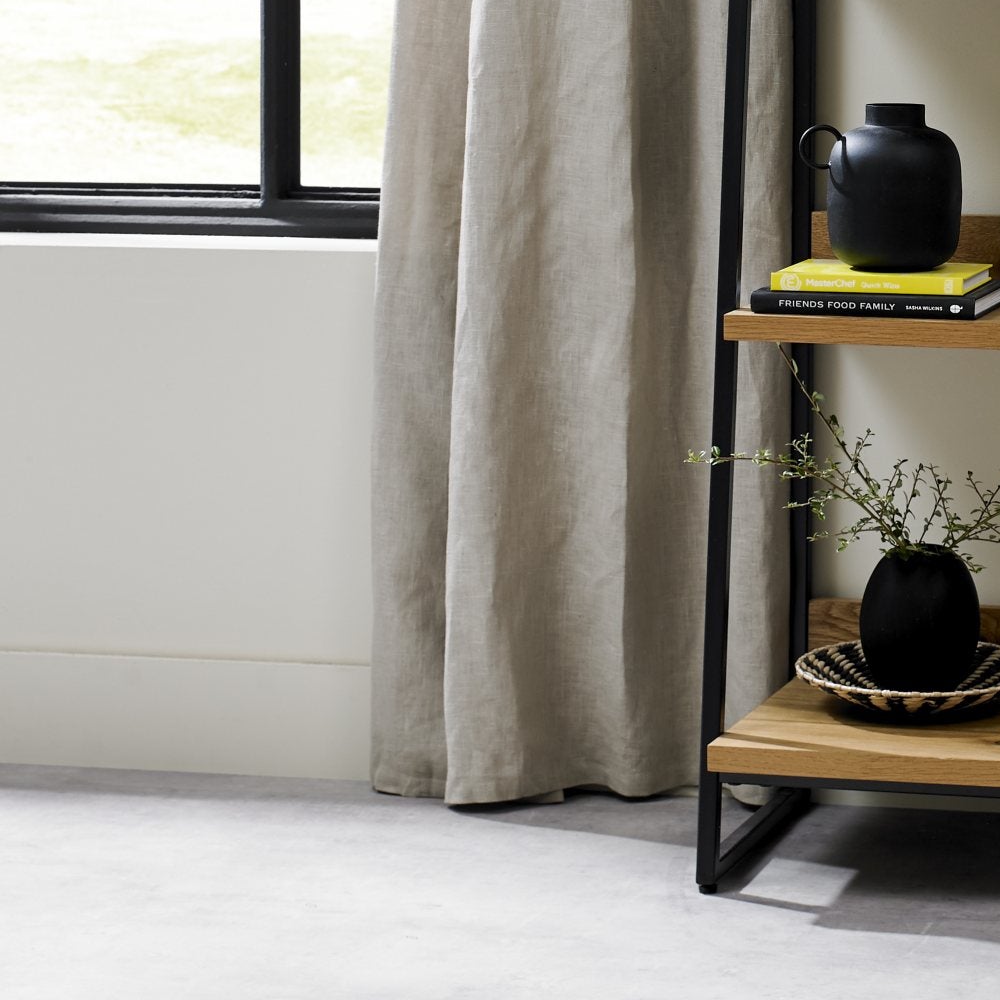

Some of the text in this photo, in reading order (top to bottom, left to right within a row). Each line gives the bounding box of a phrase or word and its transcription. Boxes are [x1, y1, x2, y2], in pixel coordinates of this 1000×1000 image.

[778, 299, 896, 311] FRIENDS FOOD FAMILY
